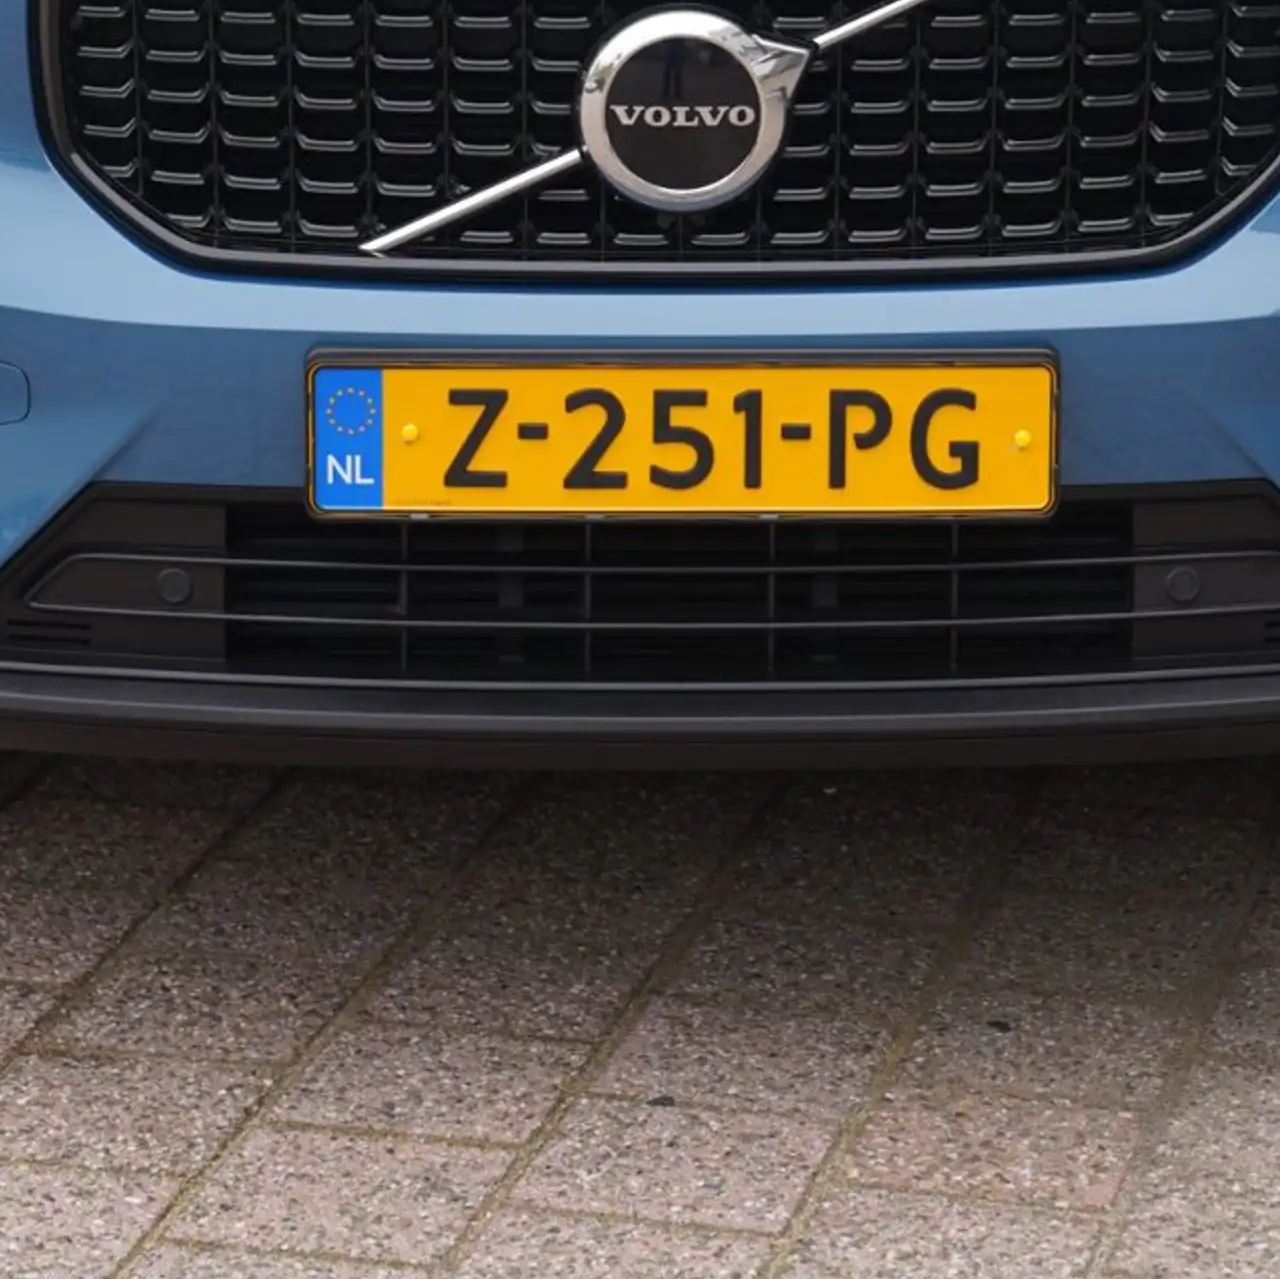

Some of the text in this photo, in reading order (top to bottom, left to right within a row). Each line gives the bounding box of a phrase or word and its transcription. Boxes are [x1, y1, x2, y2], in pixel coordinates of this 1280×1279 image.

[609, 104, 756, 127] VOLVO
[443, 388, 981, 490] Z-251-PG
[326, 454, 375, 485] NL
